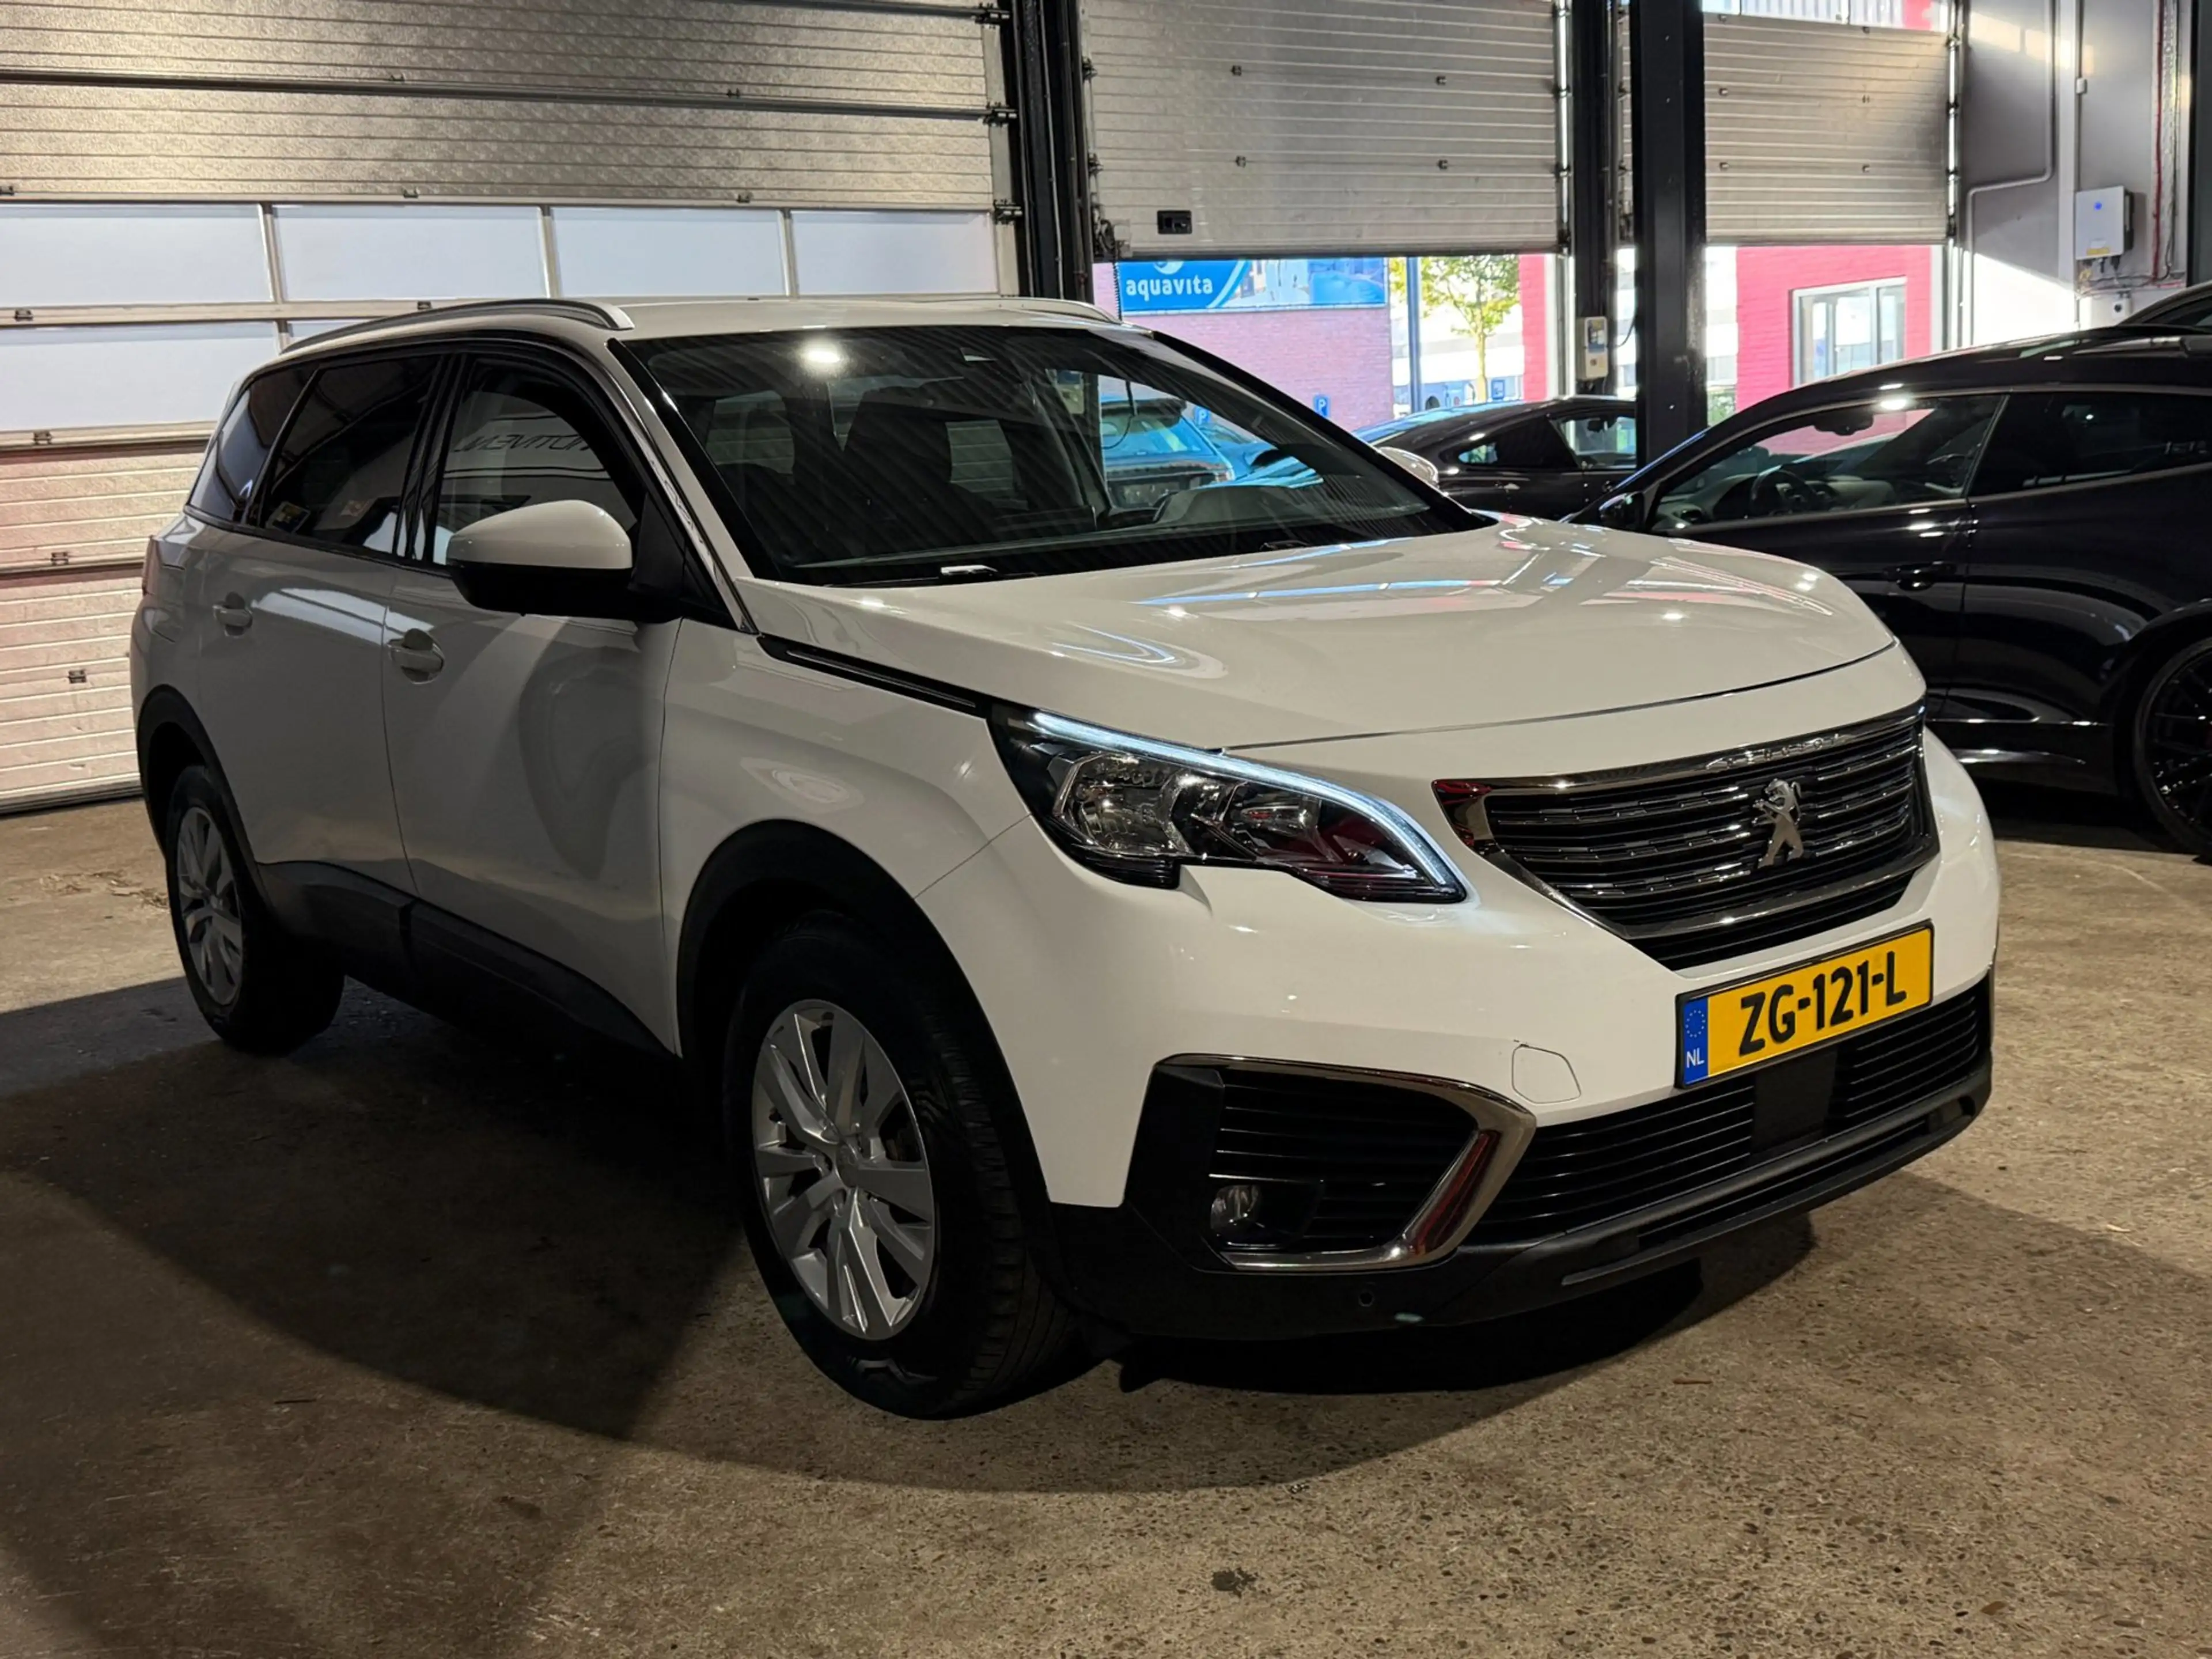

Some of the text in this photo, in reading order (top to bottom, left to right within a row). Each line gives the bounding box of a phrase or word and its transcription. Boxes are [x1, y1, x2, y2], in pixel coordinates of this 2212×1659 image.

[1126, 274, 1213, 301] aquavita
[1319, 399, 1326, 414] P
[1198, 410, 1207, 425] P
[1738, 950, 1907, 1056] ZG-121-L
[1686, 1047, 1705, 1068] NL
